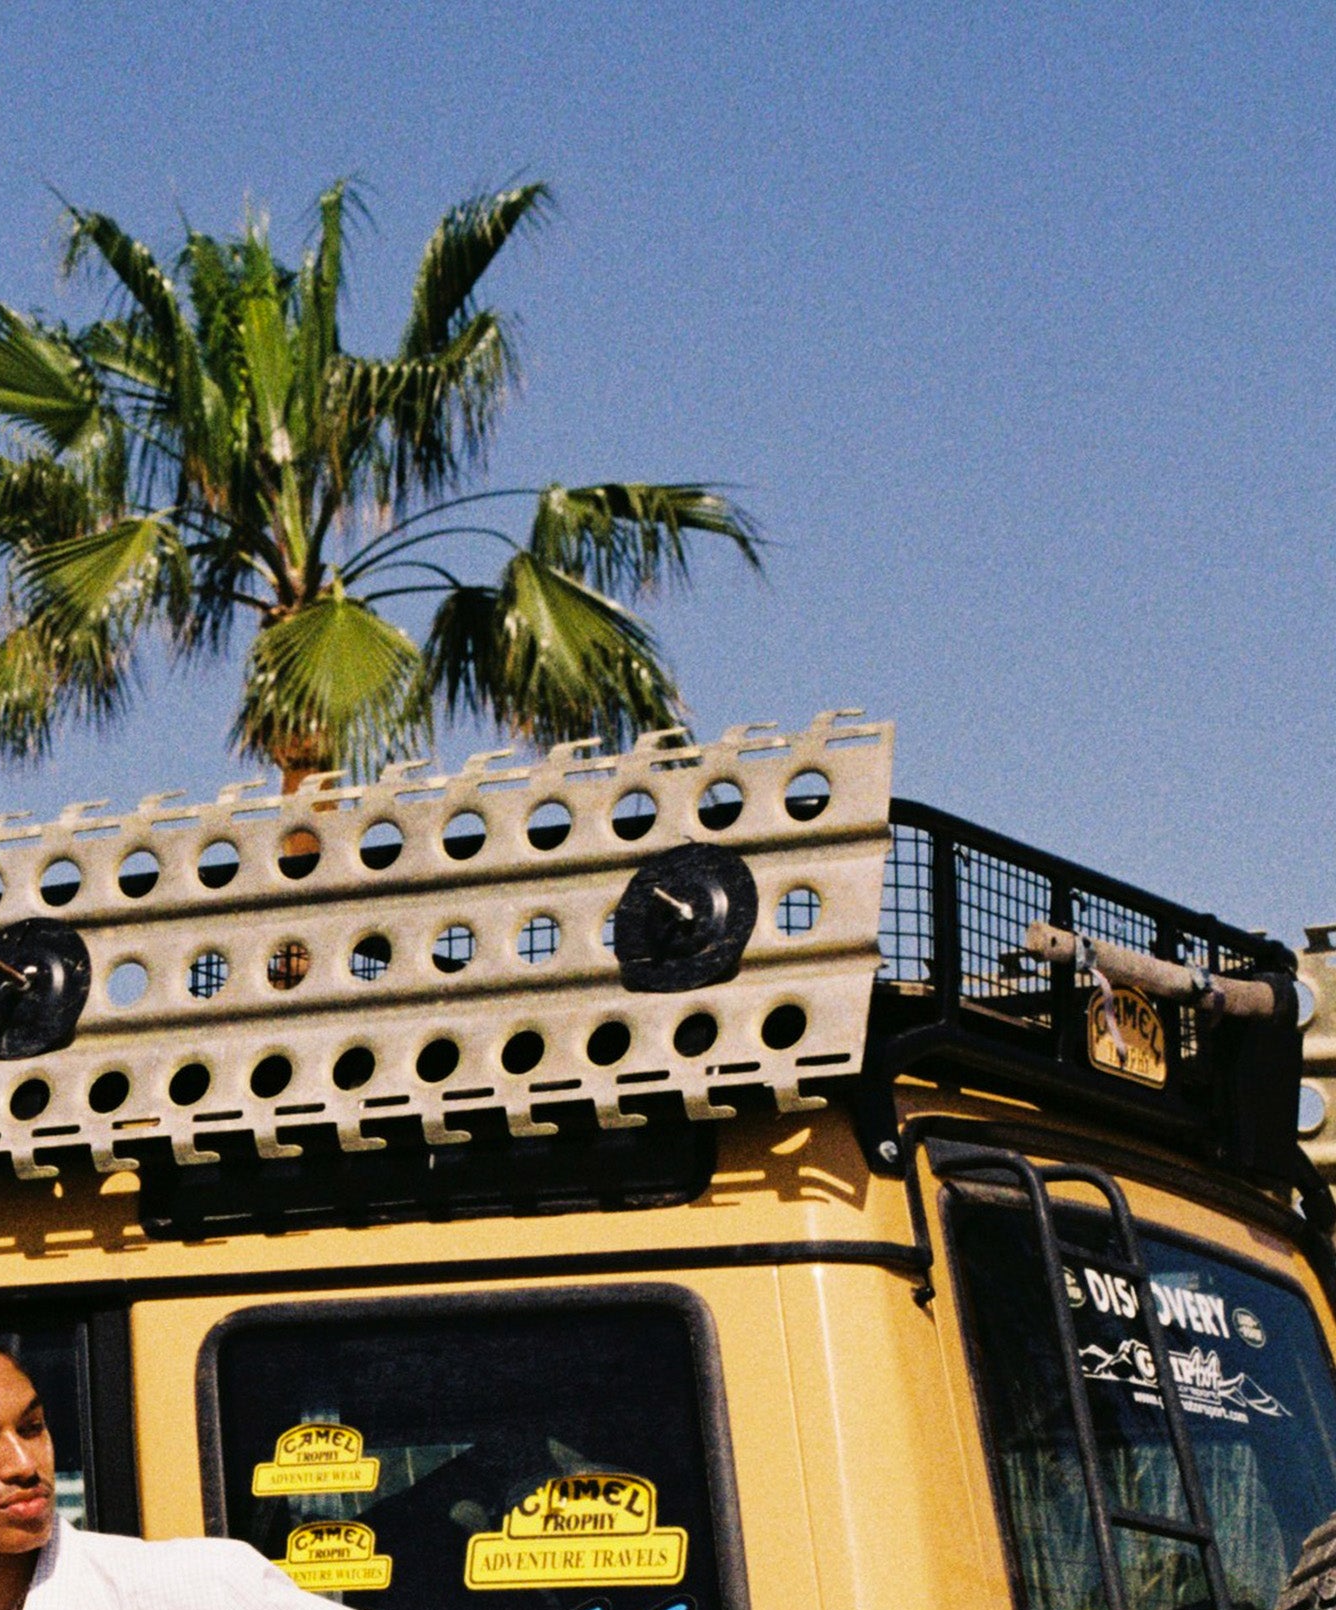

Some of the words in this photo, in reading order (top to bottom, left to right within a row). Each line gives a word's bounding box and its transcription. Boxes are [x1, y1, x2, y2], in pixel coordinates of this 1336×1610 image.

[1084, 1267, 1230, 1339] DISOVERY
[283, 1430, 356, 1454] CAMEL
[541, 1512, 617, 1532] TROPHY
[295, 1527, 366, 1551] CAMEL
[480, 1551, 585, 1572] ADVENTURE
[593, 1549, 667, 1568] TRAVELS
